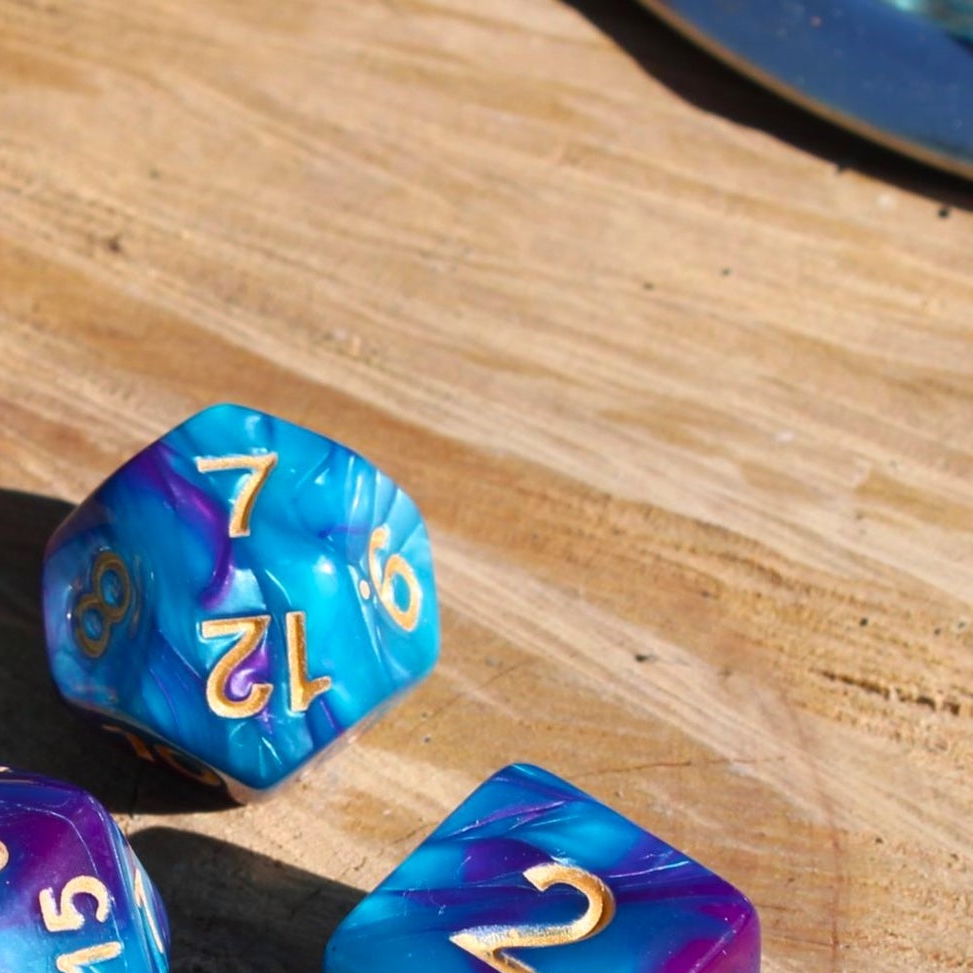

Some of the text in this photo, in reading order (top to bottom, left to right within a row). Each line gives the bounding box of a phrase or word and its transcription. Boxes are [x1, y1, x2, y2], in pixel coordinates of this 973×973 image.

[195, 452, 278, 538] 7
[74, 549, 130, 659] 8
[200, 611, 332, 720] 12
